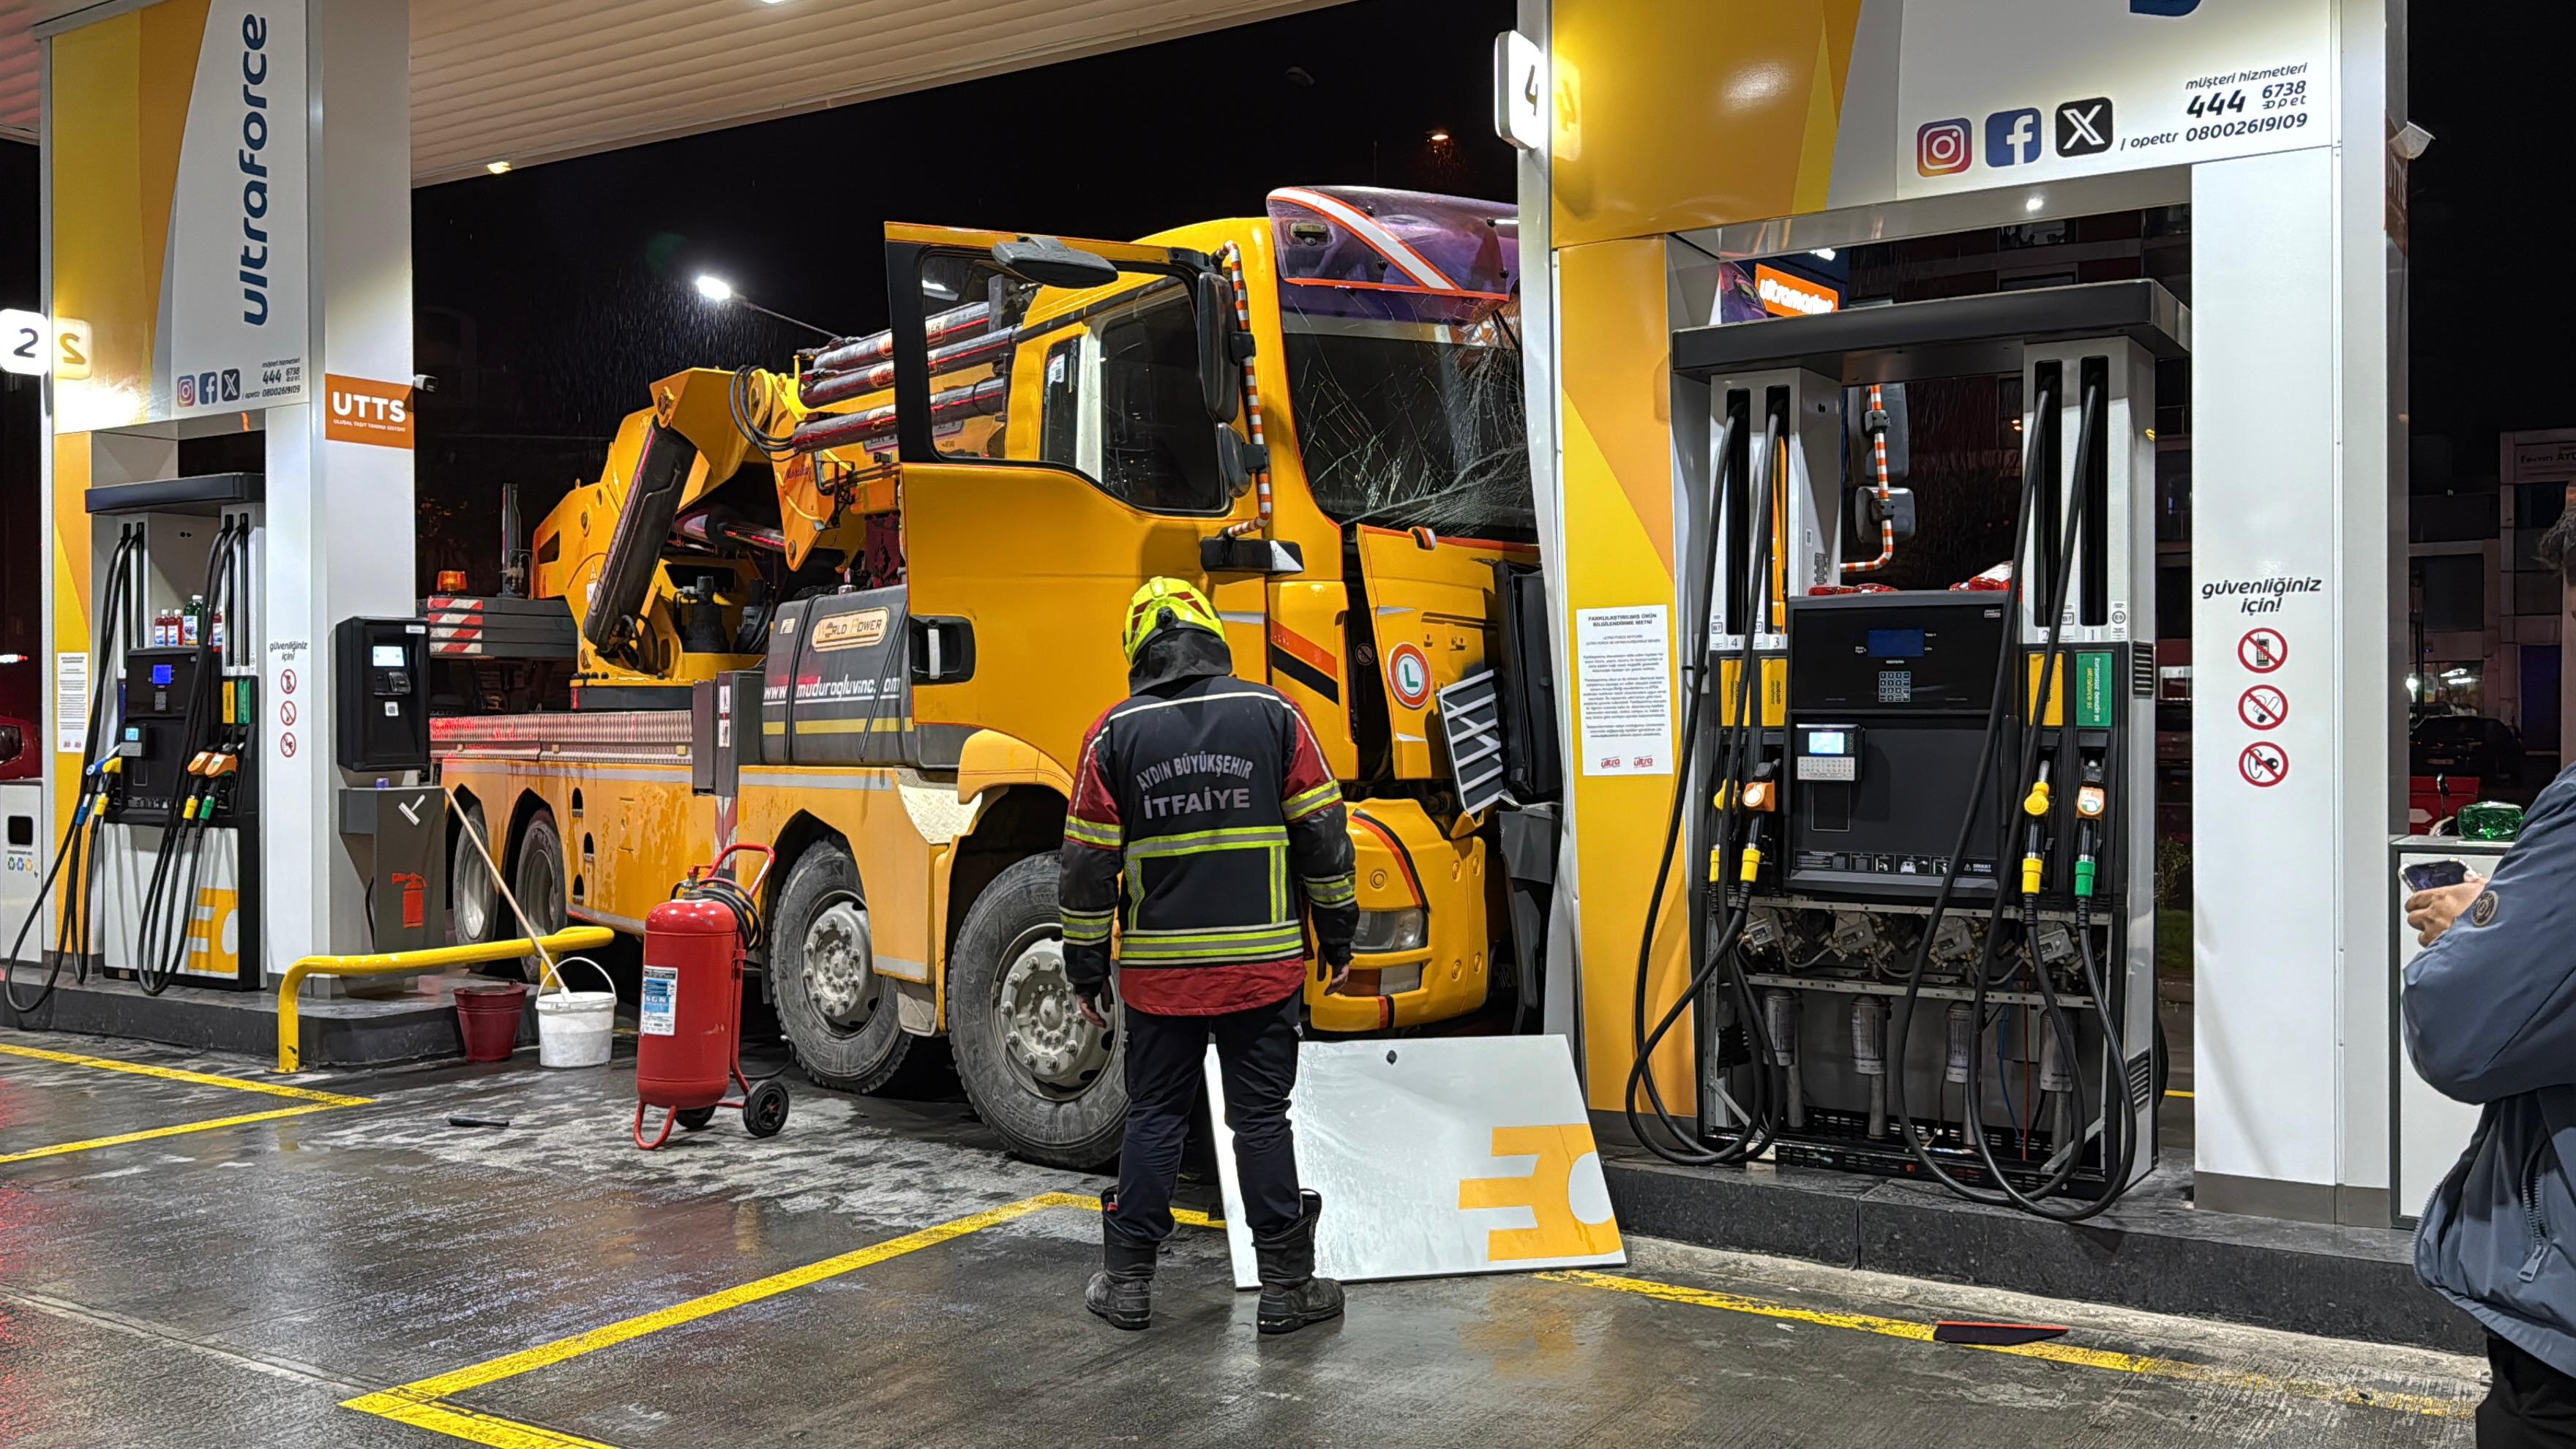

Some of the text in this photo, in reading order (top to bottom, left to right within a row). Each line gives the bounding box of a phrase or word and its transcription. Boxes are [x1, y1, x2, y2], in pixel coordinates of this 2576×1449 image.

[2185, 62, 2307, 90] müşteri hizmetleri
[2187, 80, 2306, 118] 444 6738
[2130, 132, 2179, 149] opettr
[2186, 113, 2307, 142] 08002619109
[239, 13, 268, 326] ultraforce
[13, 327, 39, 358] 2
[263, 369, 282, 384] 444
[333, 392, 406, 422] UTTS
[2201, 577, 2322, 599] güvenliğiniz
[2240, 597, 2283, 616] için!
[1731, 638, 1738, 648] 4
[1774, 637, 1780, 648] 3
[2042, 630, 2049, 642] 2
[2091, 629, 2094, 640] 1
[1403, 664, 1418, 688] L
[1136, 761, 1172, 791] AYDIN
[1144, 787, 1250, 820] İTFAİYE
